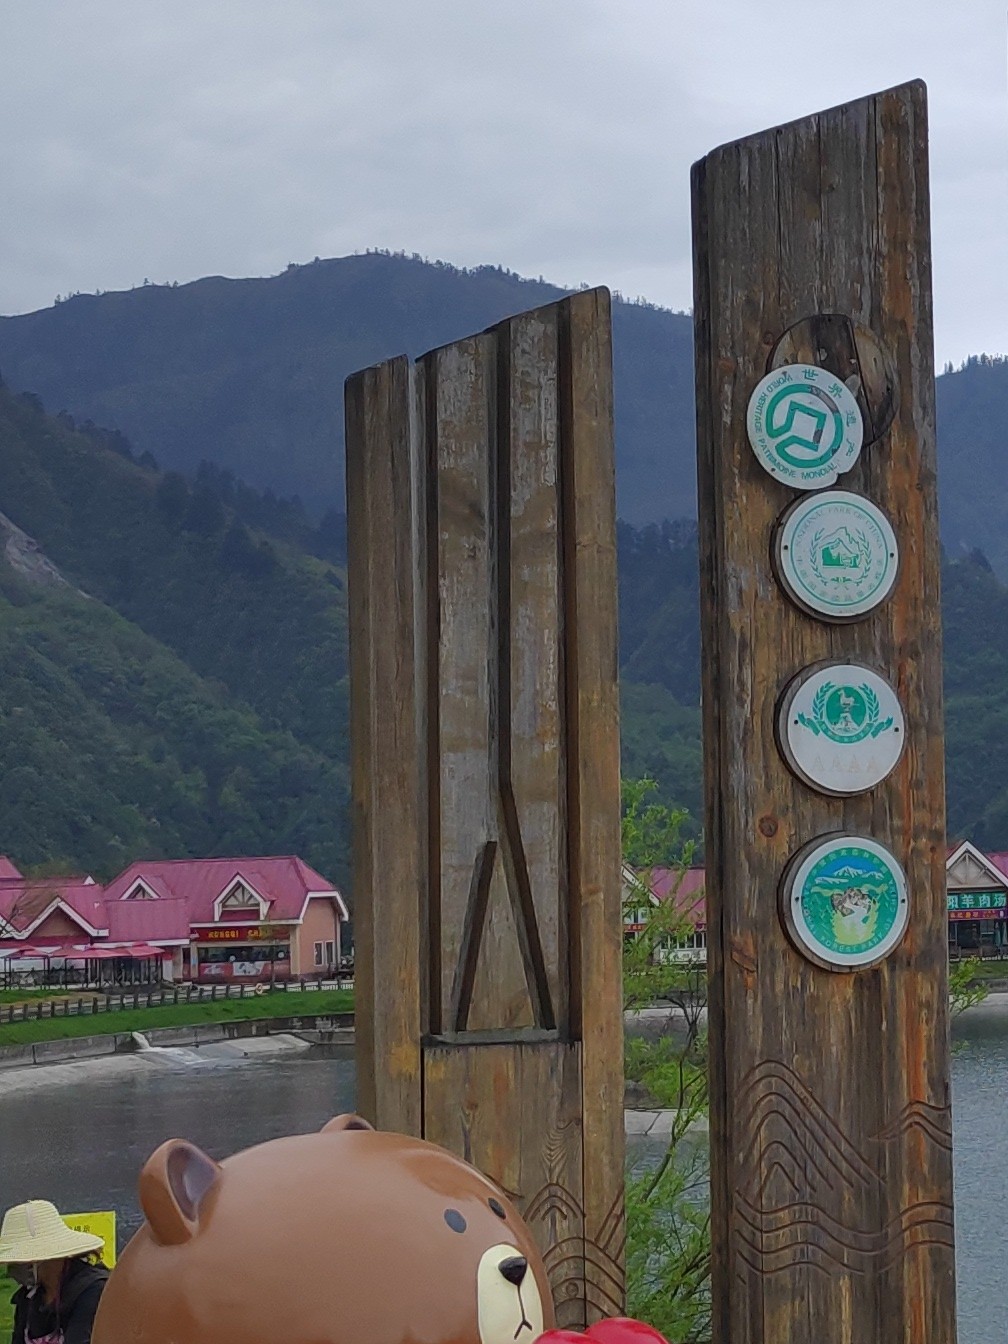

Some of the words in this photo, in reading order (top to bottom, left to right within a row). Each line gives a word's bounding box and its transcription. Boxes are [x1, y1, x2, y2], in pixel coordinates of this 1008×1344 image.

[766, 374, 794, 394] WORLD
[754, 393, 768, 433] HERITAGE
[801, 462, 838, 480] MONDIAL
